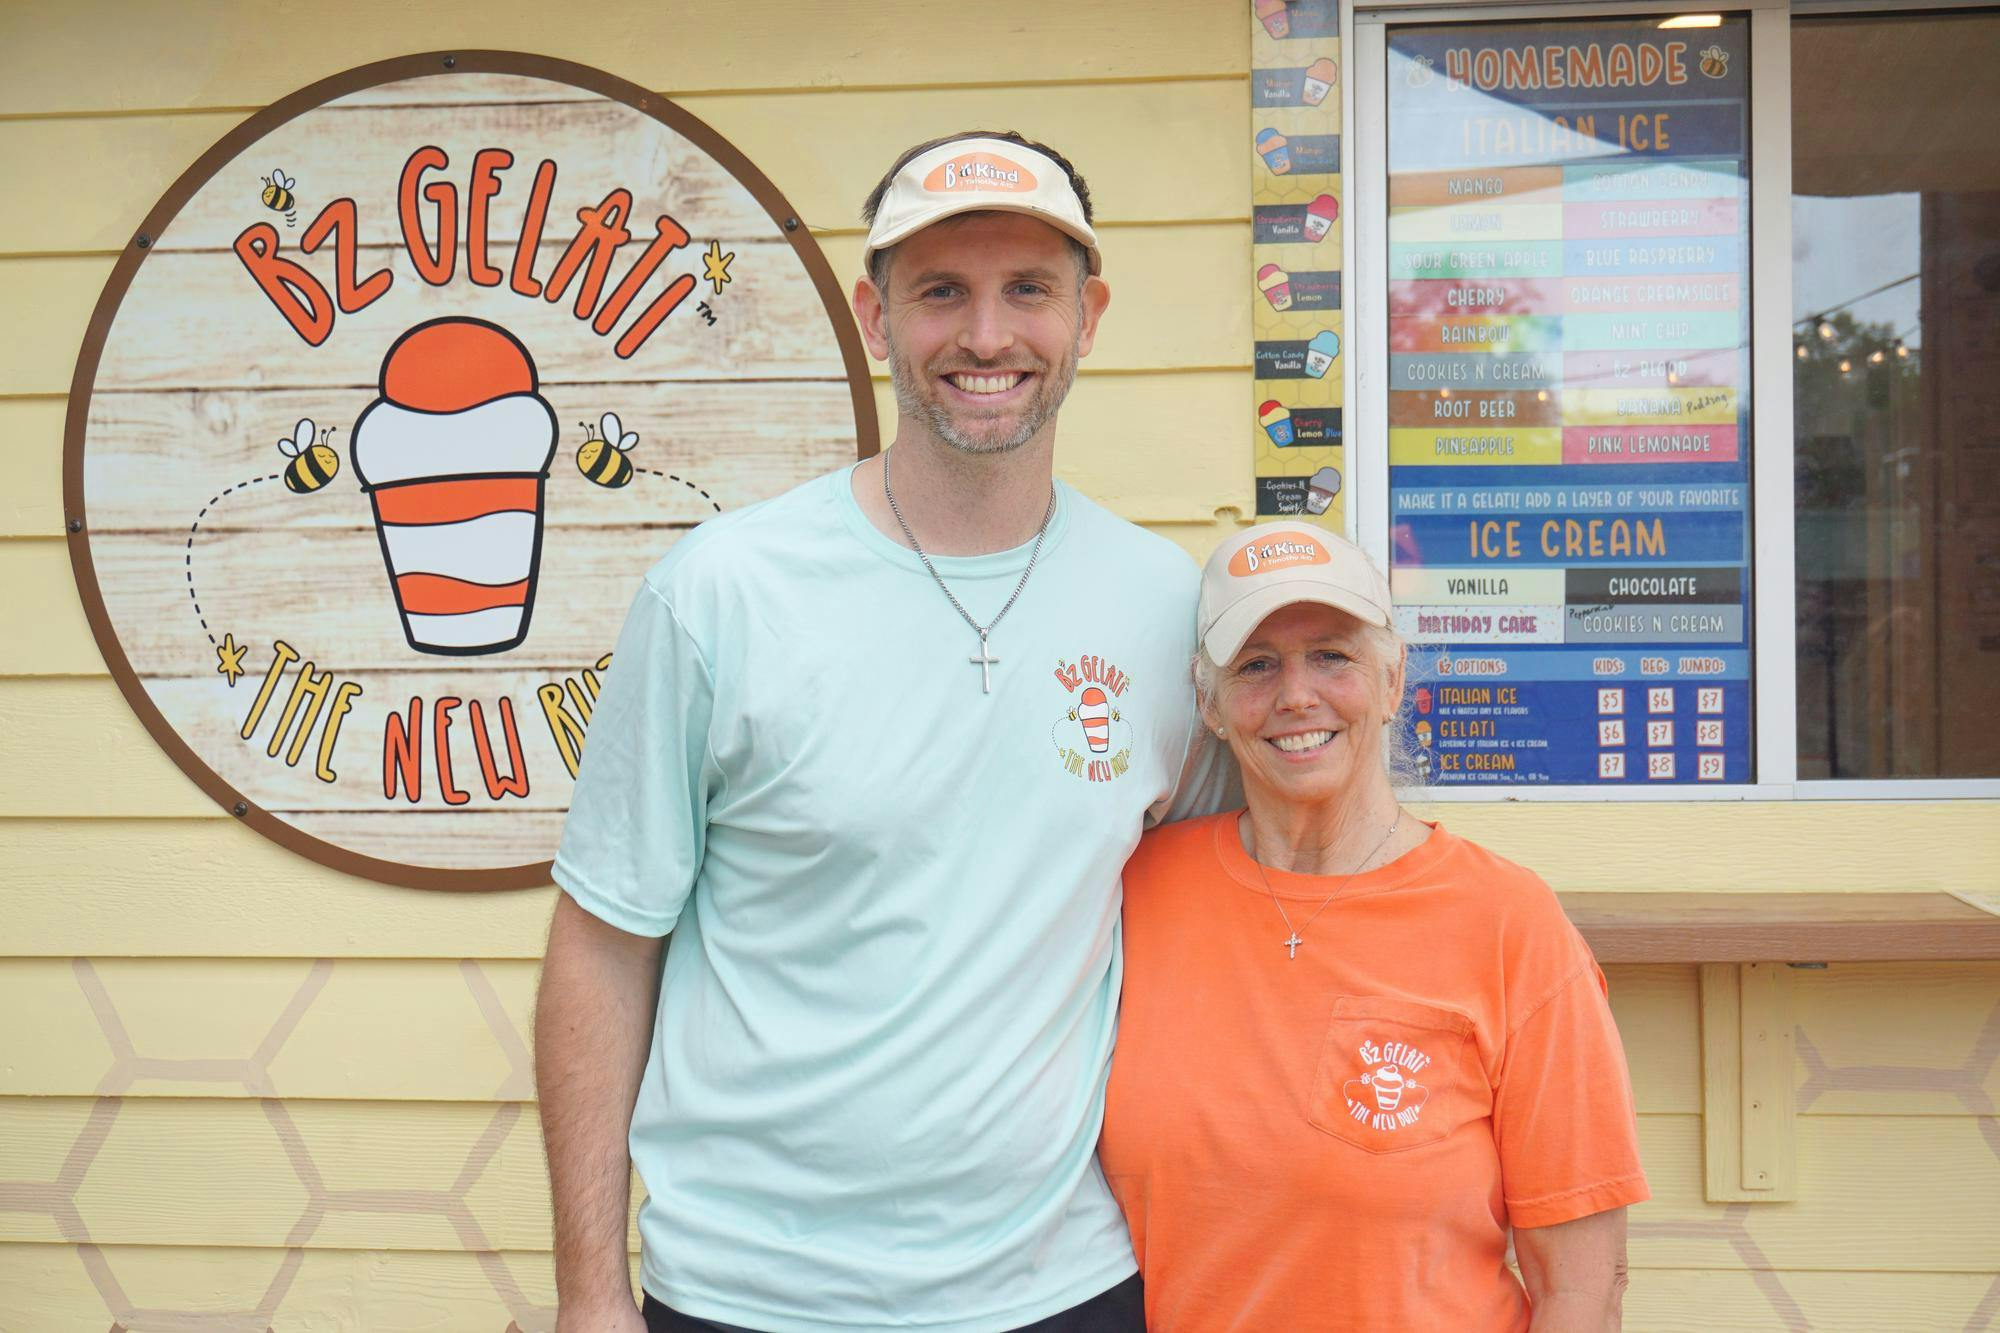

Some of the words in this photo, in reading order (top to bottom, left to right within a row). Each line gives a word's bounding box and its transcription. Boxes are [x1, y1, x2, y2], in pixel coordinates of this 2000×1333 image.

[1446, 42, 1688, 91] HOMEMADE
[1263, 89, 1291, 99] Vanilla
[1463, 115, 1595, 156] ITALIAN
[1618, 114, 1670, 151] ICE
[975, 163, 1019, 183] Kind
[1448, 178, 1504, 195] MANGO
[1601, 209, 1700, 230] STRAWBERRY
[1272, 224, 1299, 235] Vanilla
[399, 145, 696, 360] GELATI
[1404, 252, 1444, 270] SOUR
[1450, 251, 1496, 269] GREEN
[1504, 250, 1549, 268] APPLE
[1585, 248, 1621, 266] BLUE
[1629, 246, 1716, 265] RASPBERRY
[1297, 292, 1322, 302] Lemon
[1447, 288, 1505, 307] CHERRY
[1571, 285, 1630, 303] ORANGE
[1637, 283, 1730, 302] CREAMSICLE
[1441, 324, 1511, 344] RAINBOW
[1611, 322, 1648, 340] MINT
[1656, 320, 1691, 339] CHIP
[1256, 350, 1280, 360] Cotton
[1283, 350, 1305, 361] Candy
[1274, 360, 1302, 370] Vanilla
[1407, 363, 1468, 381] COOKIES
[1475, 363, 1485, 380] N
[1493, 362, 1546, 380] CREAM
[1434, 401, 1471, 419] ROOT
[1479, 400, 1516, 418] BEER
[1617, 399, 1682, 416] BANANA
[1297, 427, 1323, 438] Lemon
[1436, 437, 1514, 455] PINEAPPLE
[1588, 436, 1623, 453] PINK
[1629, 434, 1711, 453] LEMONADE
[1266, 480, 1297, 490] Cookies
[1276, 491, 1302, 501] Cream
[1398, 493, 1436, 509] MAKE
[1441, 493, 1453, 508] IT
[1458, 493, 1466, 508] A
[1525, 492, 1552, 507] ADD
[1557, 492, 1565, 507] A
[1572, 491, 1612, 507] LAYER
[1617, 491, 1633, 506] OF
[1639, 490, 1674, 506] YOUR
[1679, 489, 1739, 505] FAVORITE
[1470, 520, 1521, 558] ICE
[1541, 518, 1666, 557] CREAM
[1275, 542, 1315, 556] Kind
[1447, 578, 1509, 595] VANILLA
[1608, 577, 1697, 596] CHOCOLATE
[1418, 615, 1492, 633] BIRTHDAY
[1498, 615, 1538, 633] CAKE
[1583, 615, 1645, 633] COOKIES
[1653, 616, 1662, 632] N
[1670, 615, 1724, 632] CREAM
[1455, 658, 1507, 675] OPTIONS:
[1594, 658, 1624, 675] KIDS:
[1641, 657, 1669, 675] REG:
[1678, 657, 1725, 674] JUMBO:
[1081, 655, 1126, 698] GELATI
[1440, 687, 1492, 705] ITALIAN
[1497, 687, 1517, 705] ICE
[1603, 692, 1618, 709] $5
[1653, 691, 1669, 709] $6
[1702, 691, 1718, 709] $7
[240, 640, 363, 783] THE
[383, 696, 530, 805] NEW
[1440, 720, 1495, 737] GELATI
[1604, 723, 1620, 742] $6
[1653, 724, 1668, 742] $7
[1699, 724, 1720, 741] $8
[1440, 754, 1460, 770] ICE
[1466, 753, 1515, 770] CREAM
[1604, 757, 1620, 773] $7
[1651, 756, 1671, 774] $8
[1703, 758, 1719, 775] $9
[1088, 760, 1112, 782] NEW
[1383, 1042, 1426, 1073] GELATI
[1372, 1113, 1396, 1130] NEW
